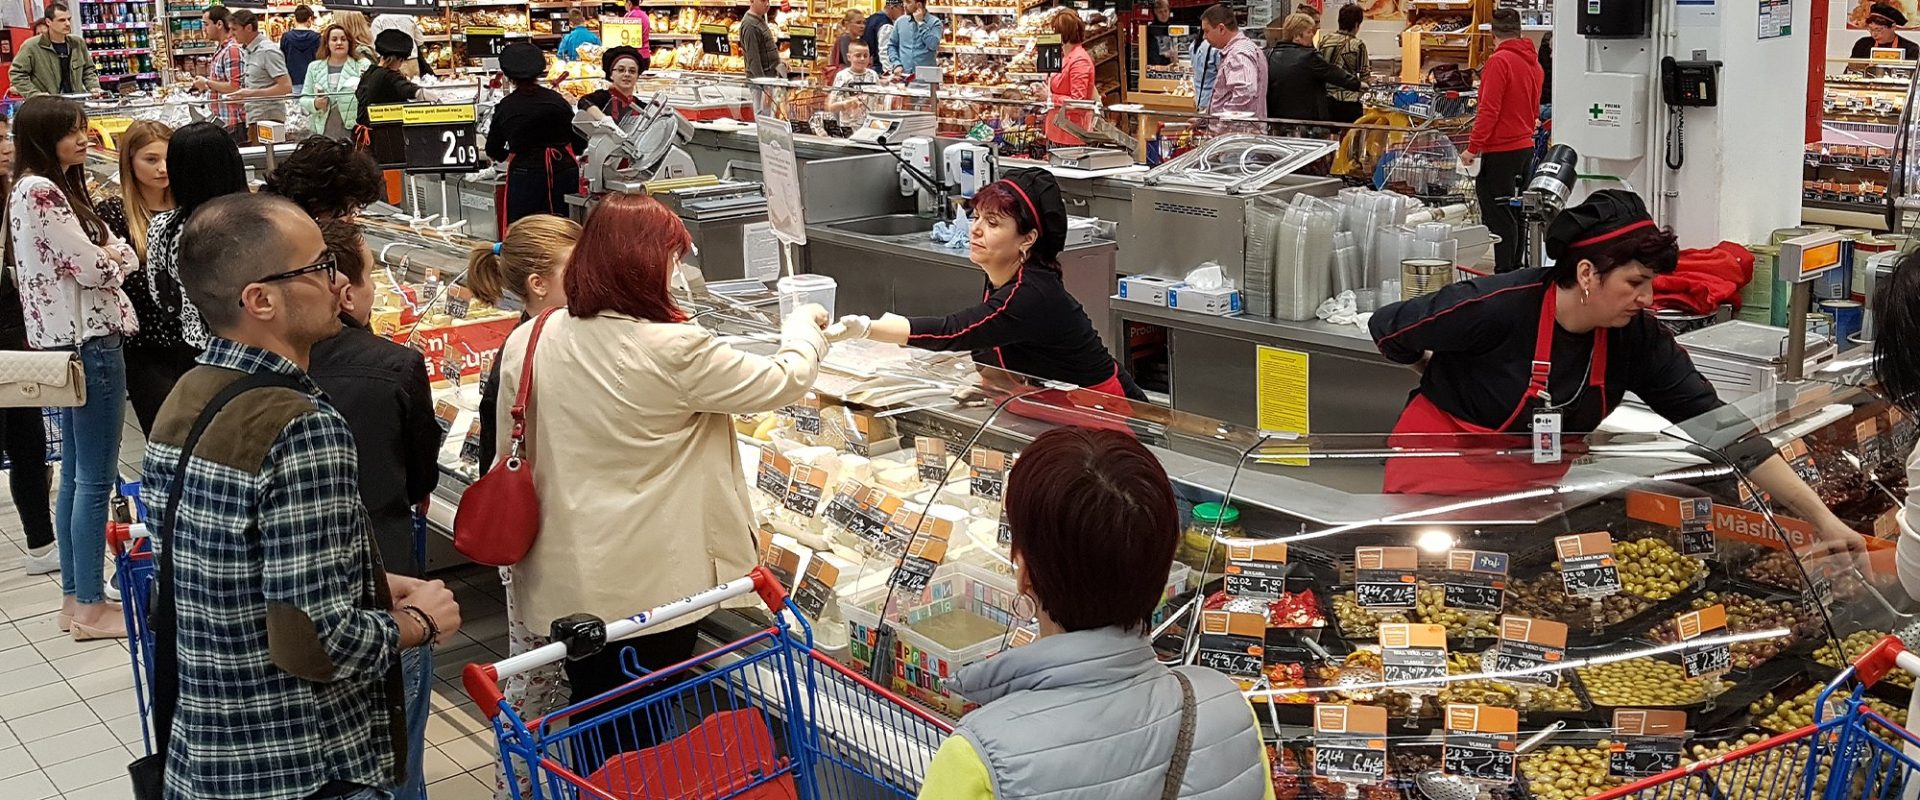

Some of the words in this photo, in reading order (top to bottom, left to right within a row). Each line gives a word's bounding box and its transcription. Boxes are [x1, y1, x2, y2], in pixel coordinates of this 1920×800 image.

[620, 29, 630, 45] 9
[716, 36, 722, 52] 1
[802, 39, 809, 56] 3
[442, 130, 457, 165] 2
[458, 146, 477, 164] 09
